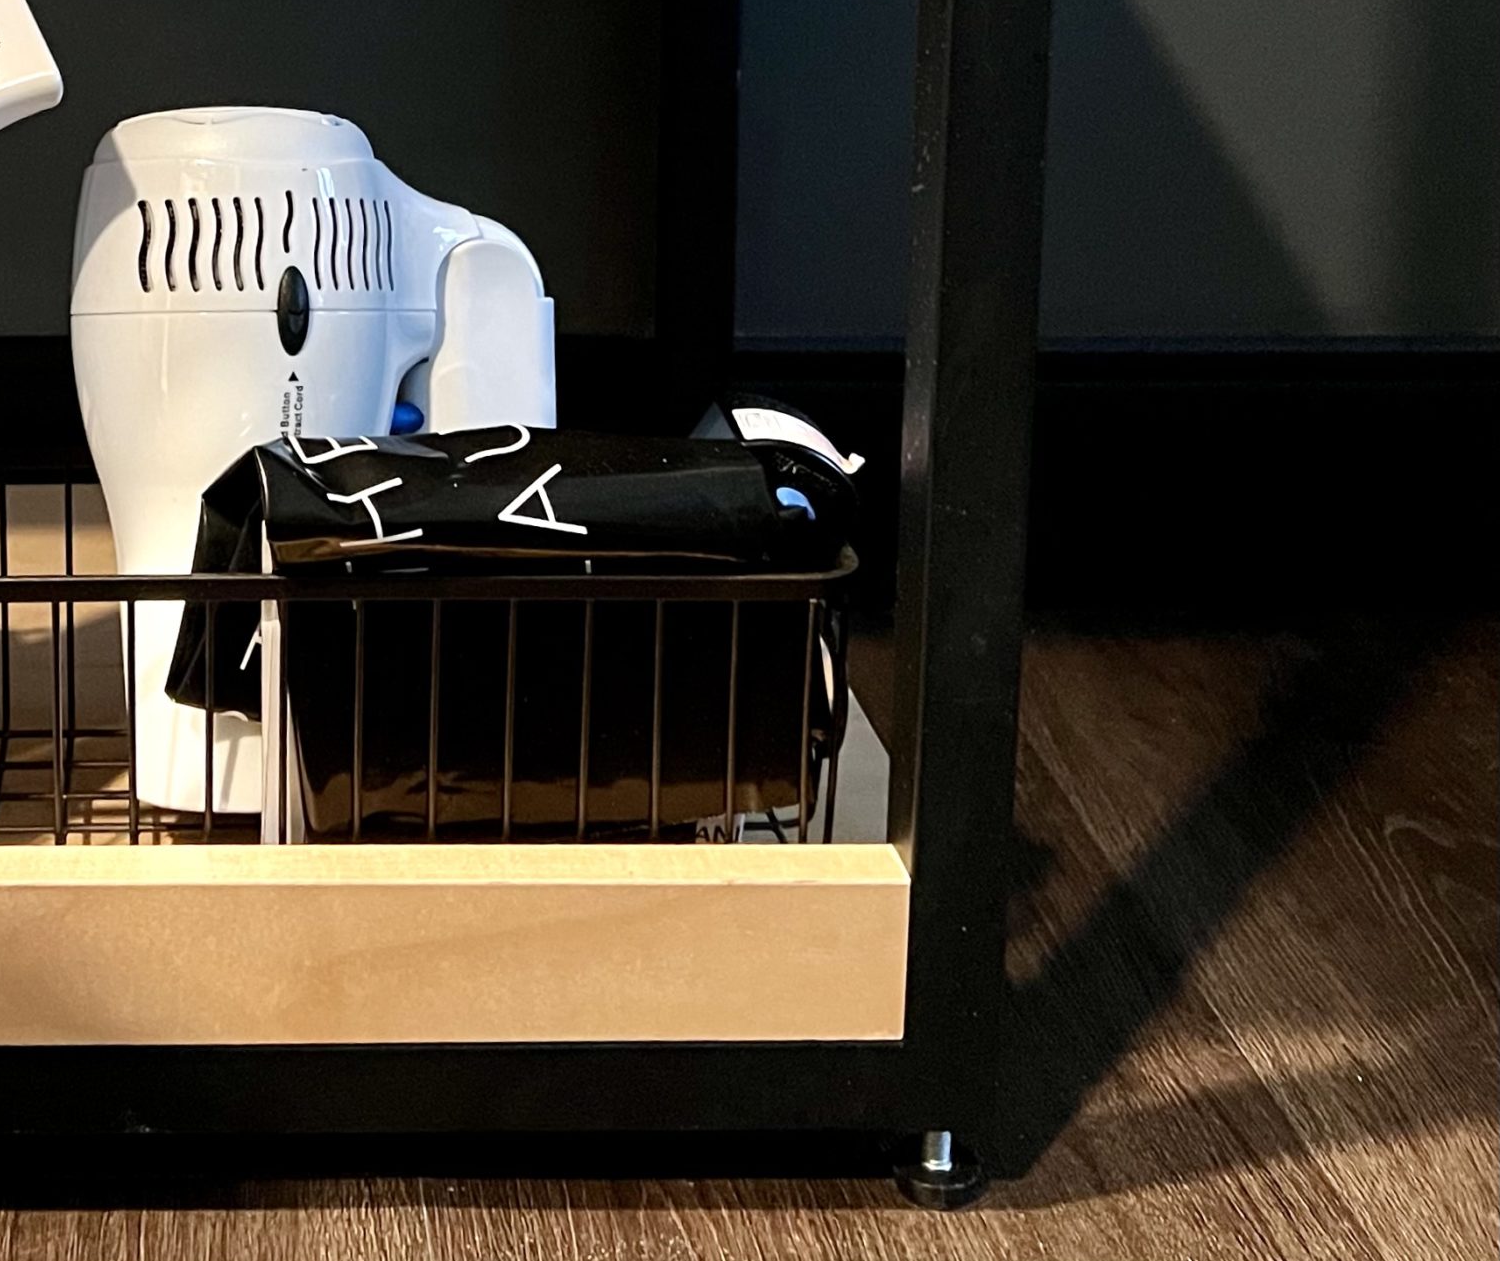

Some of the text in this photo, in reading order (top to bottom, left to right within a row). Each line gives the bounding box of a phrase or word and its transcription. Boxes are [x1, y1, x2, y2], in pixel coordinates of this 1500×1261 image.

[280, 392, 291, 427] Button
[293, 385, 304, 437] tract Cord
